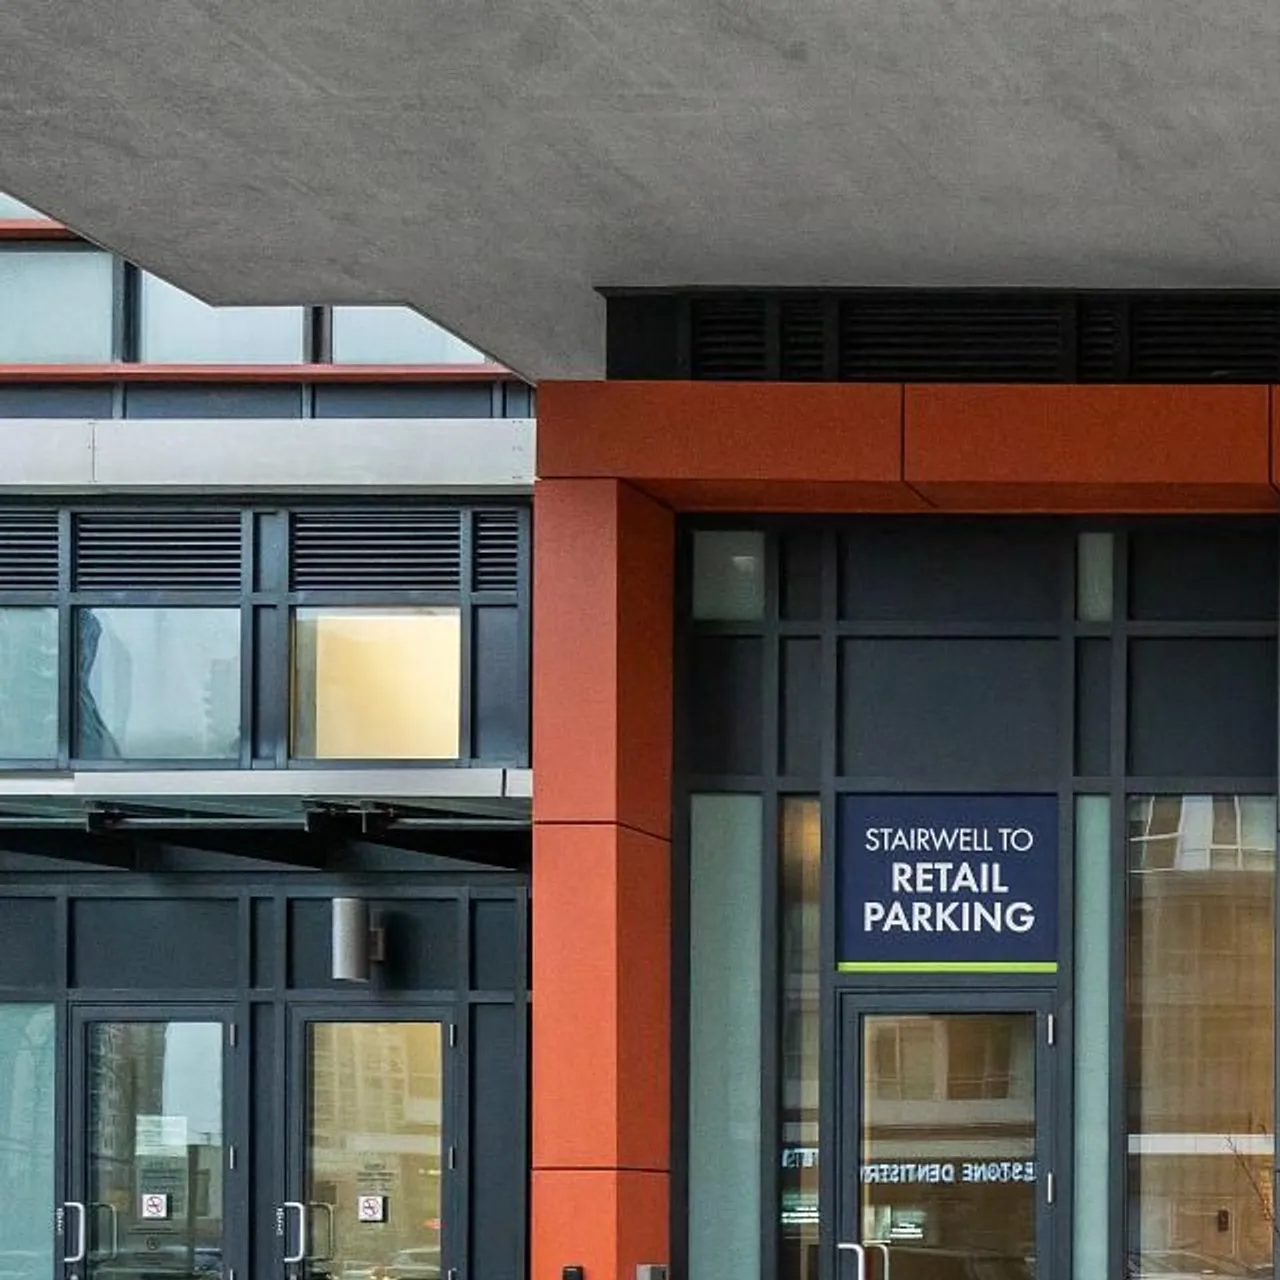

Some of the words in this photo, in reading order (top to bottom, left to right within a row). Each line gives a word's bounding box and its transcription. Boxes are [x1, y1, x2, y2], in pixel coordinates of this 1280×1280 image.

[865, 828, 993, 852] STAIRWELL
[998, 828, 1034, 852] TO
[892, 862, 1009, 893] RETAIL
[863, 901, 1036, 933] PARKING
